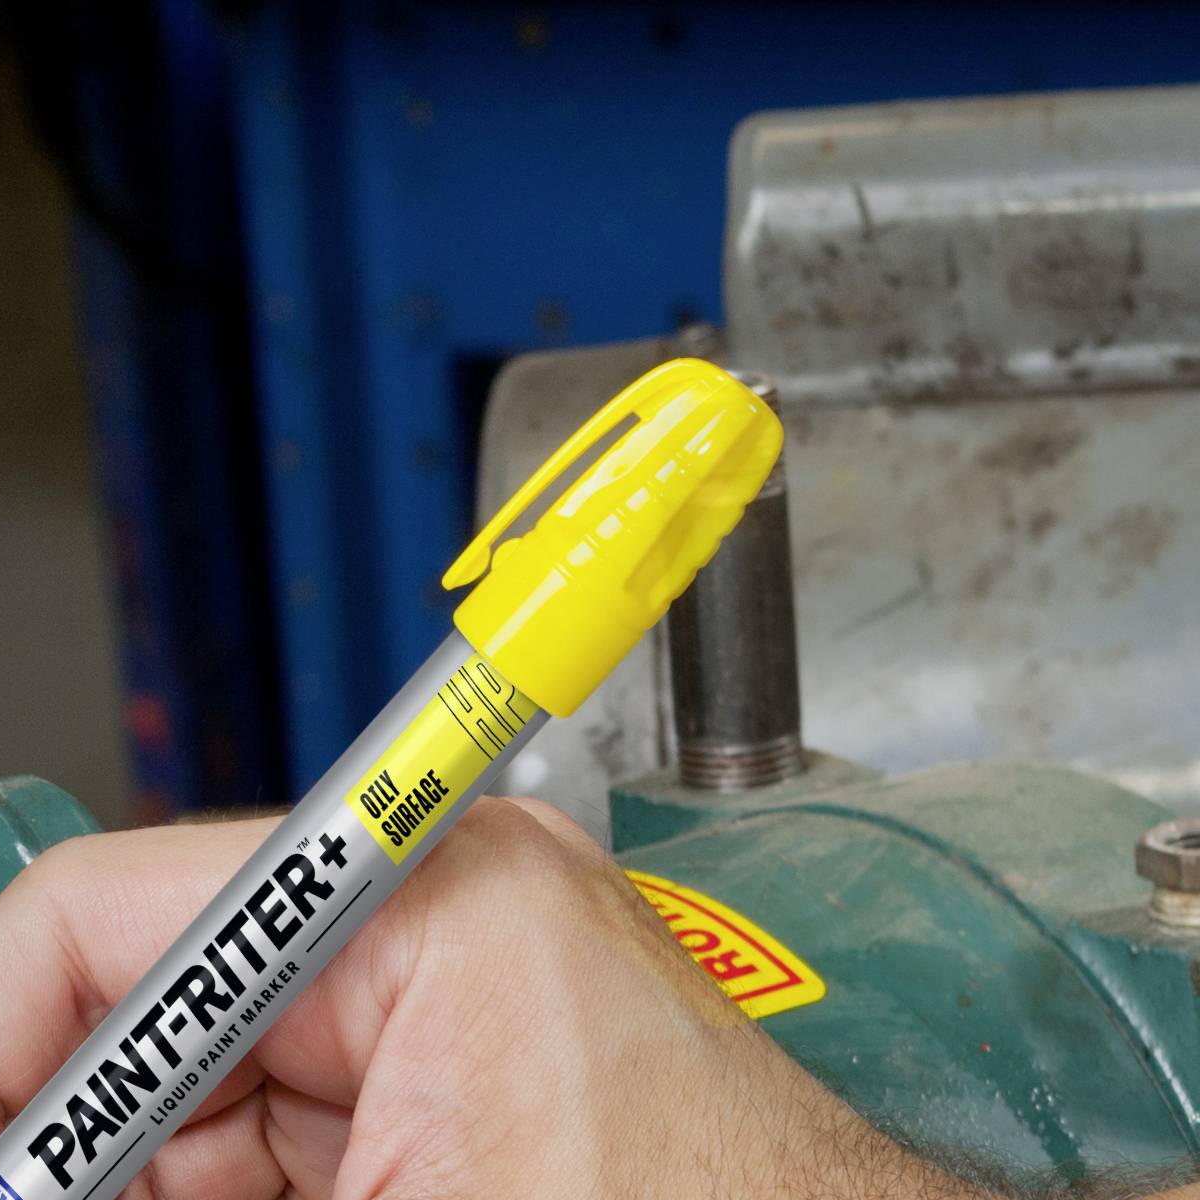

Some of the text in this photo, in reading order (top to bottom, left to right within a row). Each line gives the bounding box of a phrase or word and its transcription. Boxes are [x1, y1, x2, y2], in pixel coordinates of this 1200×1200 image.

[359, 769, 401, 820] OILY
[380, 769, 450, 847] SURFACE
[149, 960, 301, 1126] LIQUID PAINT MARKER
